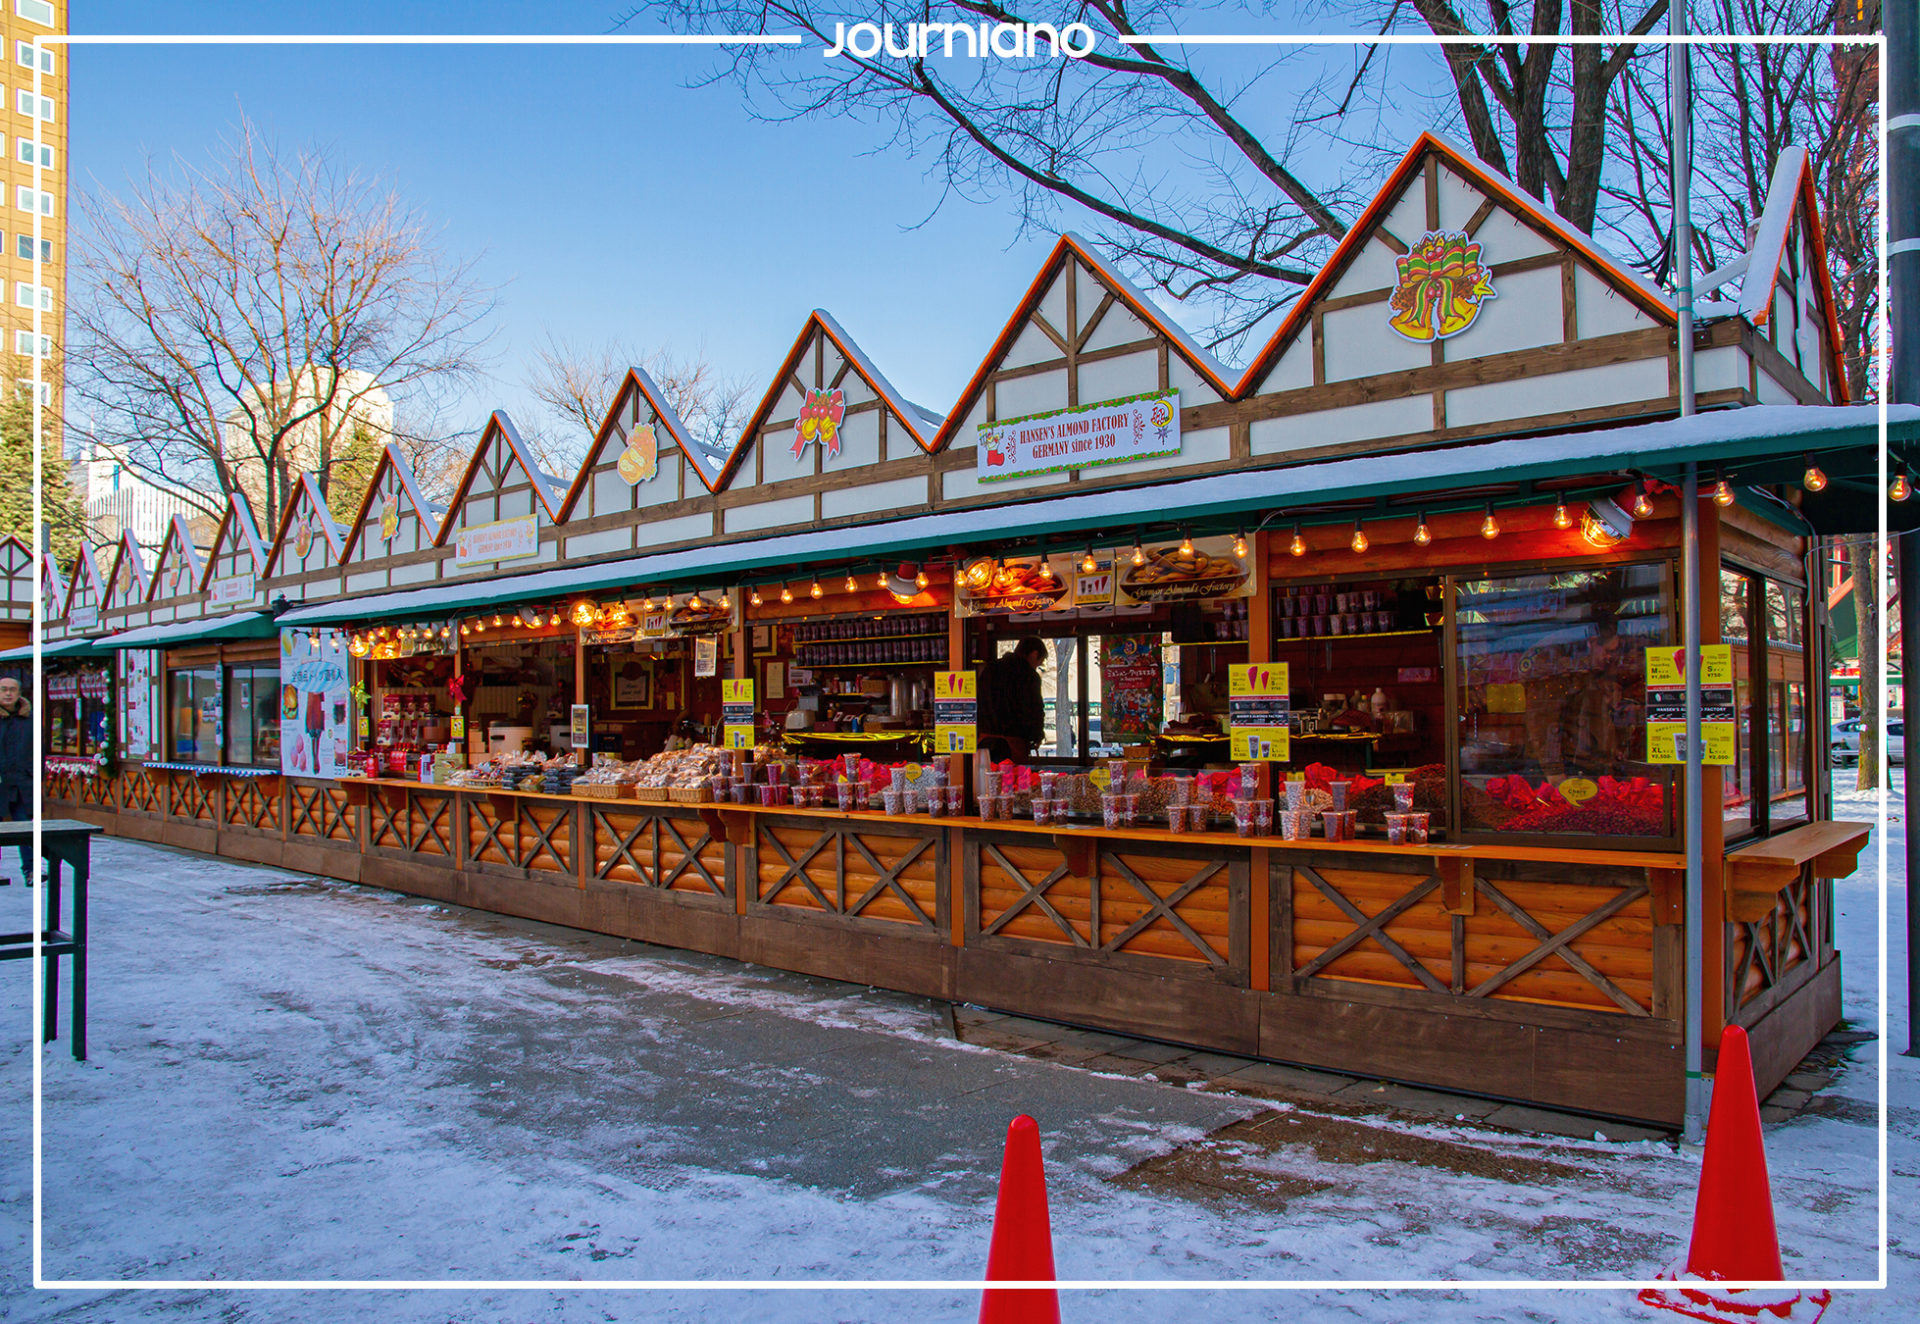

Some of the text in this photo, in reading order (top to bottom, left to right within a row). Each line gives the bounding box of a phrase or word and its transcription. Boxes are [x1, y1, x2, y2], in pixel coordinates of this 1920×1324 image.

[1019, 413, 1129, 445] HANSEN'S ALMOND FACTORY
[1032, 433, 1116, 460] GERMANY since 1930
